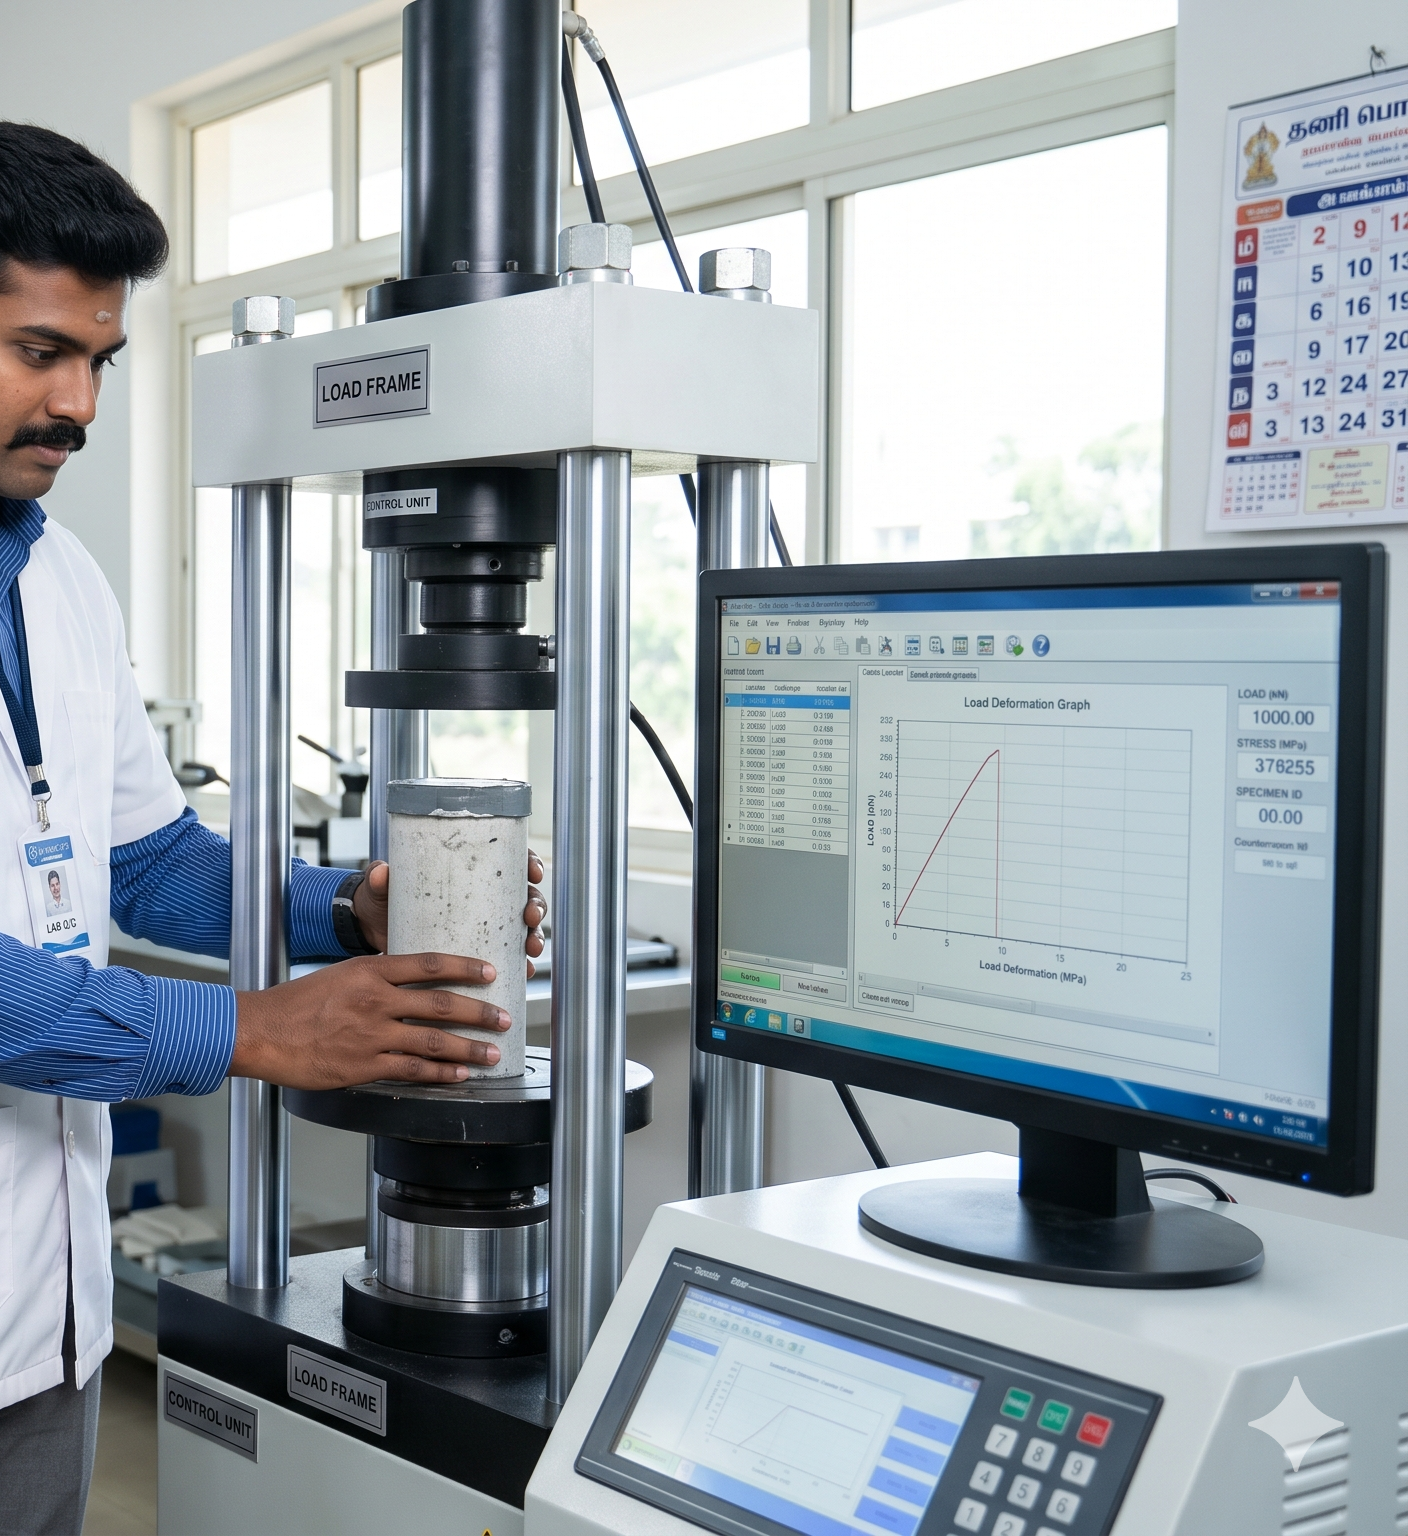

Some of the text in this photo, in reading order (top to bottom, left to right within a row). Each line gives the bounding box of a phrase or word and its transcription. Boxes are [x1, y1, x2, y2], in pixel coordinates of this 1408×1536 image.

[1313, 226, 1326, 245] 2
[1354, 219, 1367, 239] 9
[1311, 264, 1324, 283] 5
[1347, 257, 1372, 278] 10
[1310, 302, 1323, 321] 6
[1346, 296, 1371, 317] 16
[1308, 330, 1408, 360] 9 17 20
[322, 371, 421, 402] LOAD FRAME
[1266, 382, 1279, 401] 3
[1302, 378, 1326, 398] 12
[1340, 373, 1368, 394] 24
[1383, 369, 1408, 390] 27
[1265, 419, 1277, 438] 3
[1301, 415, 1325, 435] 13
[1339, 411, 1367, 432] 24
[1381, 408, 1407, 428] 31
[406, 497, 431, 508] UNIT
[964, 697, 1091, 713] Load Deformation Graph
[1238, 689, 1266, 699] LOAD
[1252, 710, 1315, 726] 1000.00
[1237, 738, 1276, 749] STRESS
[1236, 787, 1303, 800] SPECIMEN ID
[1258, 808, 1303, 825] 00.00
[47, 922, 61, 934] LAB
[892, 932, 1192, 981] 0 5 10 15 20 25
[979, 960, 1087, 986] Load Deformation (MPa)
[294, 1365, 377, 1414] LOAD FRAME
[168, 1390, 252, 1439] CONTROL UNIT
[995, 1432, 1083, 1476] 7 8 9
[979, 1470, 1068, 1514] 4 5 6
[967, 1507, 1013, 1536] 1 2
